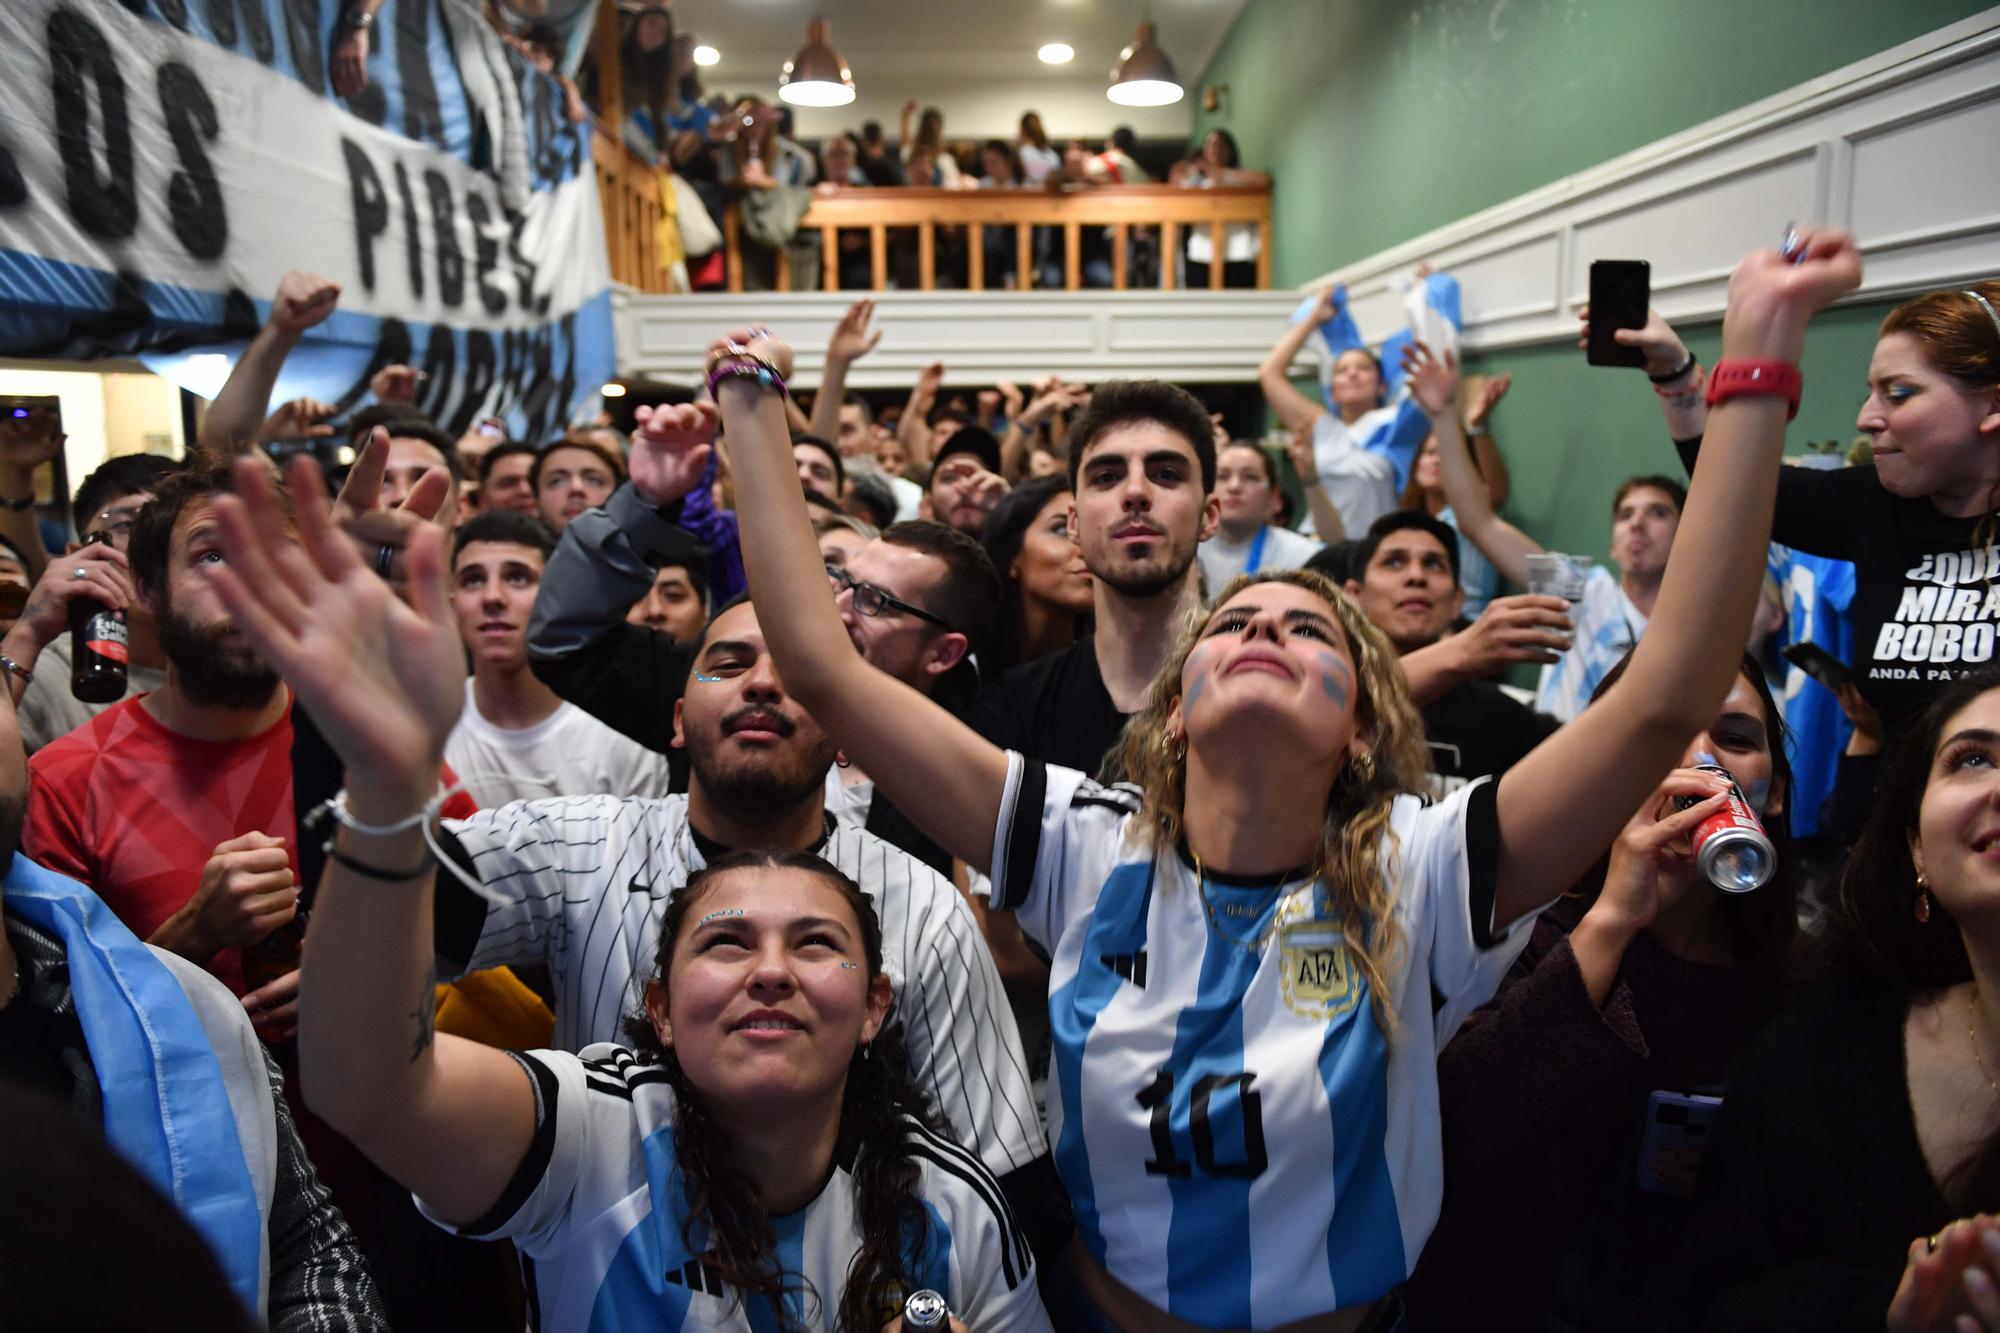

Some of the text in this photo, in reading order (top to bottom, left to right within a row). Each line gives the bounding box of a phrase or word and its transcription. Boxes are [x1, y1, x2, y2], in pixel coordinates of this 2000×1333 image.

[0, 10, 227, 261] OS
[1869, 667, 1920, 679] ANDÁ
[1299, 951, 1342, 985] AFA
[1135, 1071, 1268, 1180] 10
